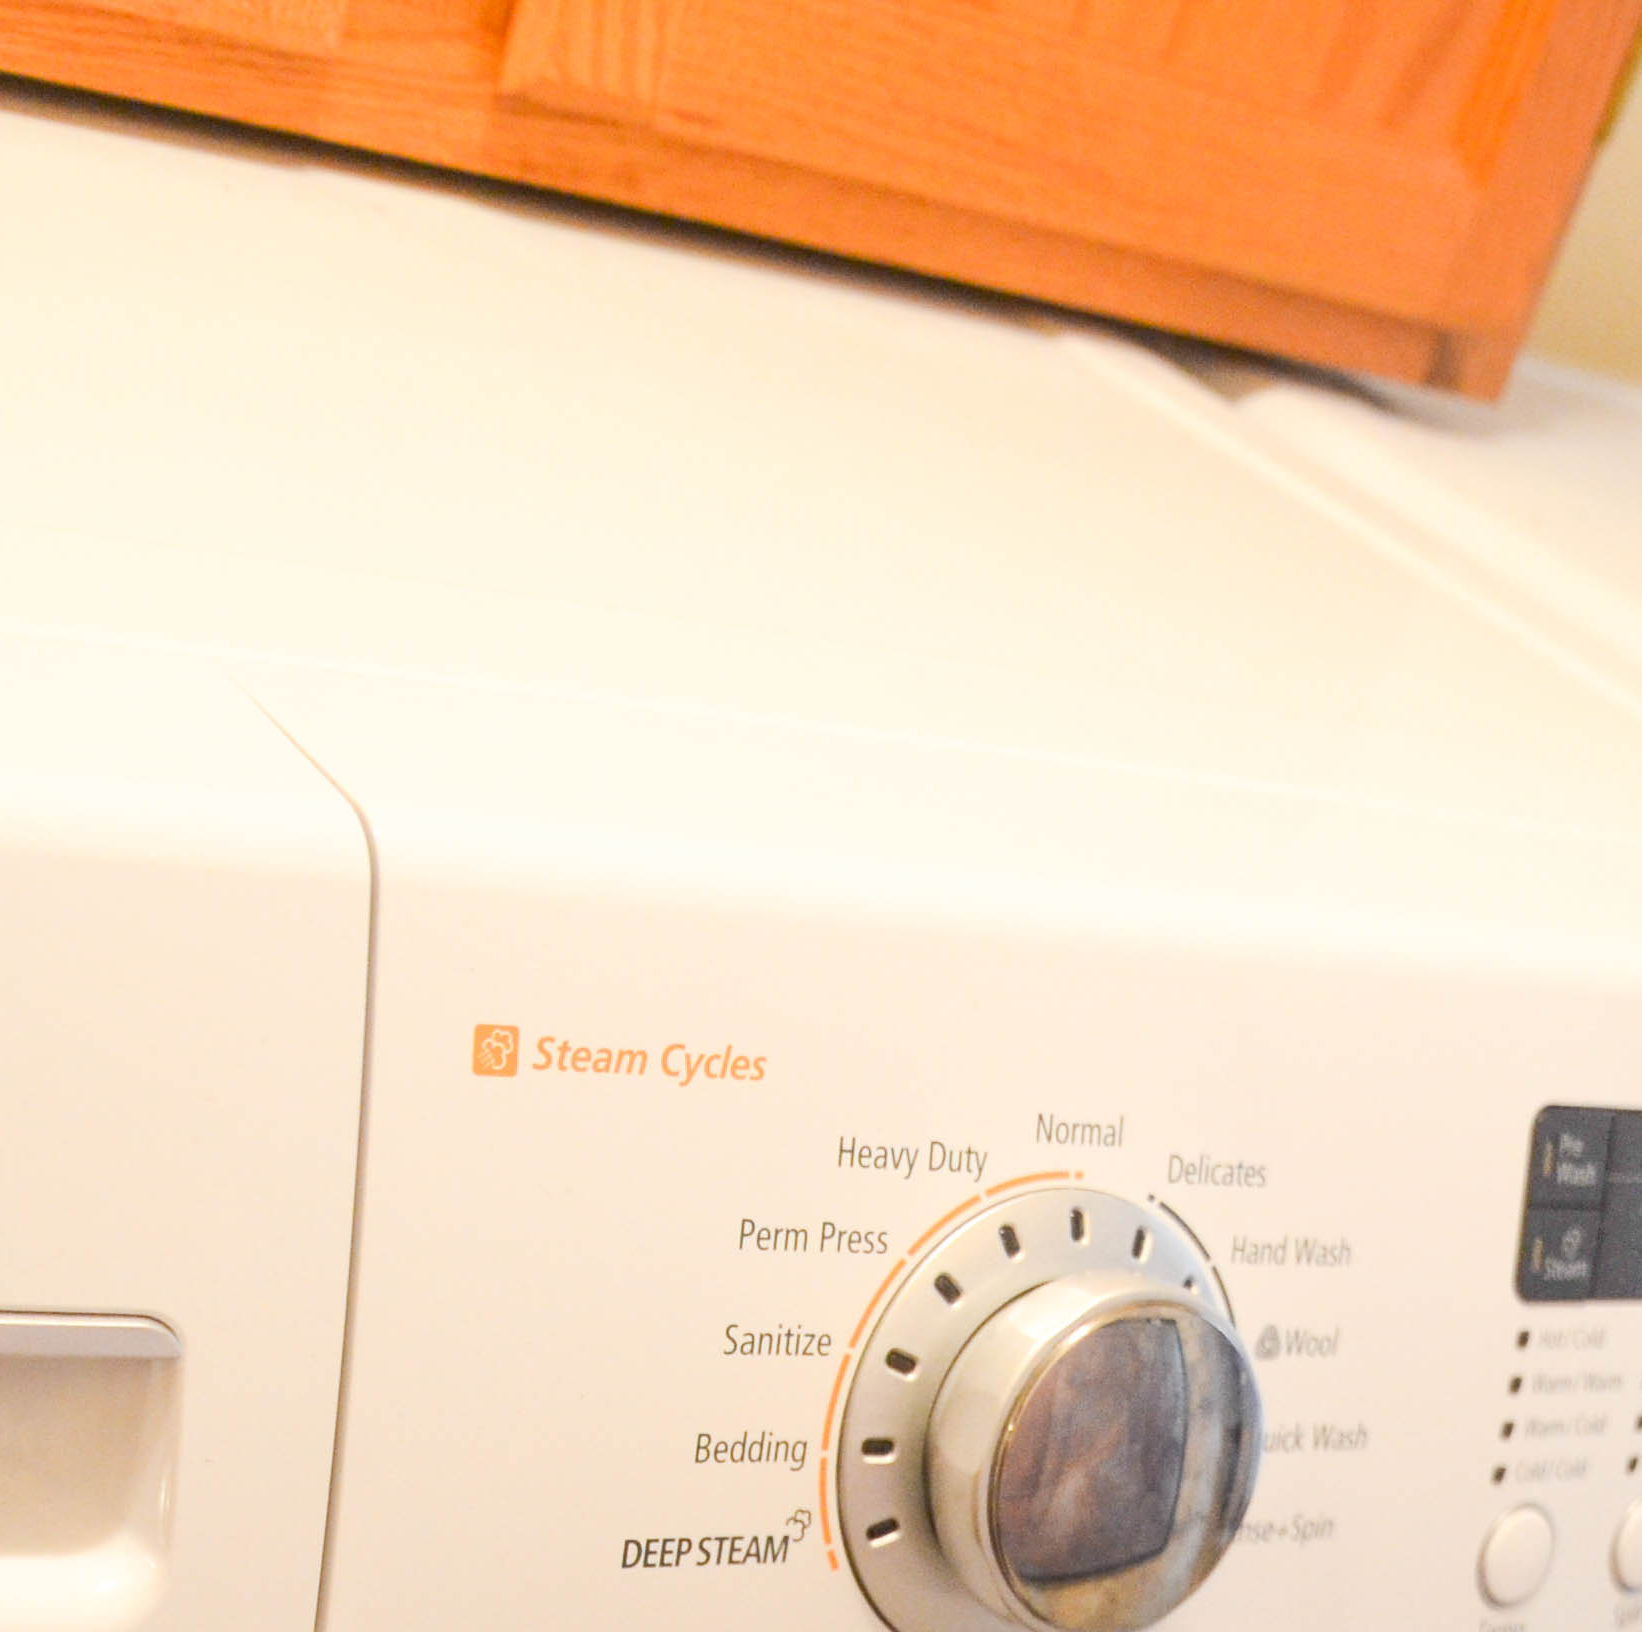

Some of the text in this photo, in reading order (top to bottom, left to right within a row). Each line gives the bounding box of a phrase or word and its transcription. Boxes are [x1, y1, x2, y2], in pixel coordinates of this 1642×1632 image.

[533, 1036, 768, 1087] Steam Cycles
[1035, 1112, 1125, 1148] Normal
[837, 1136, 989, 1182] Heavy Duty
[1166, 1153, 1268, 1189] Delicates
[739, 1218, 889, 1255] Perm Press
[1231, 1234, 1353, 1268] Hand Wash
[723, 1323, 833, 1358] Sanitize
[1285, 1326, 1341, 1359] Wool
[694, 1432, 808, 1471] Bedding
[1260, 1420, 1369, 1454] uick Wash
[621, 1535, 790, 1570] DEEP STEAM
